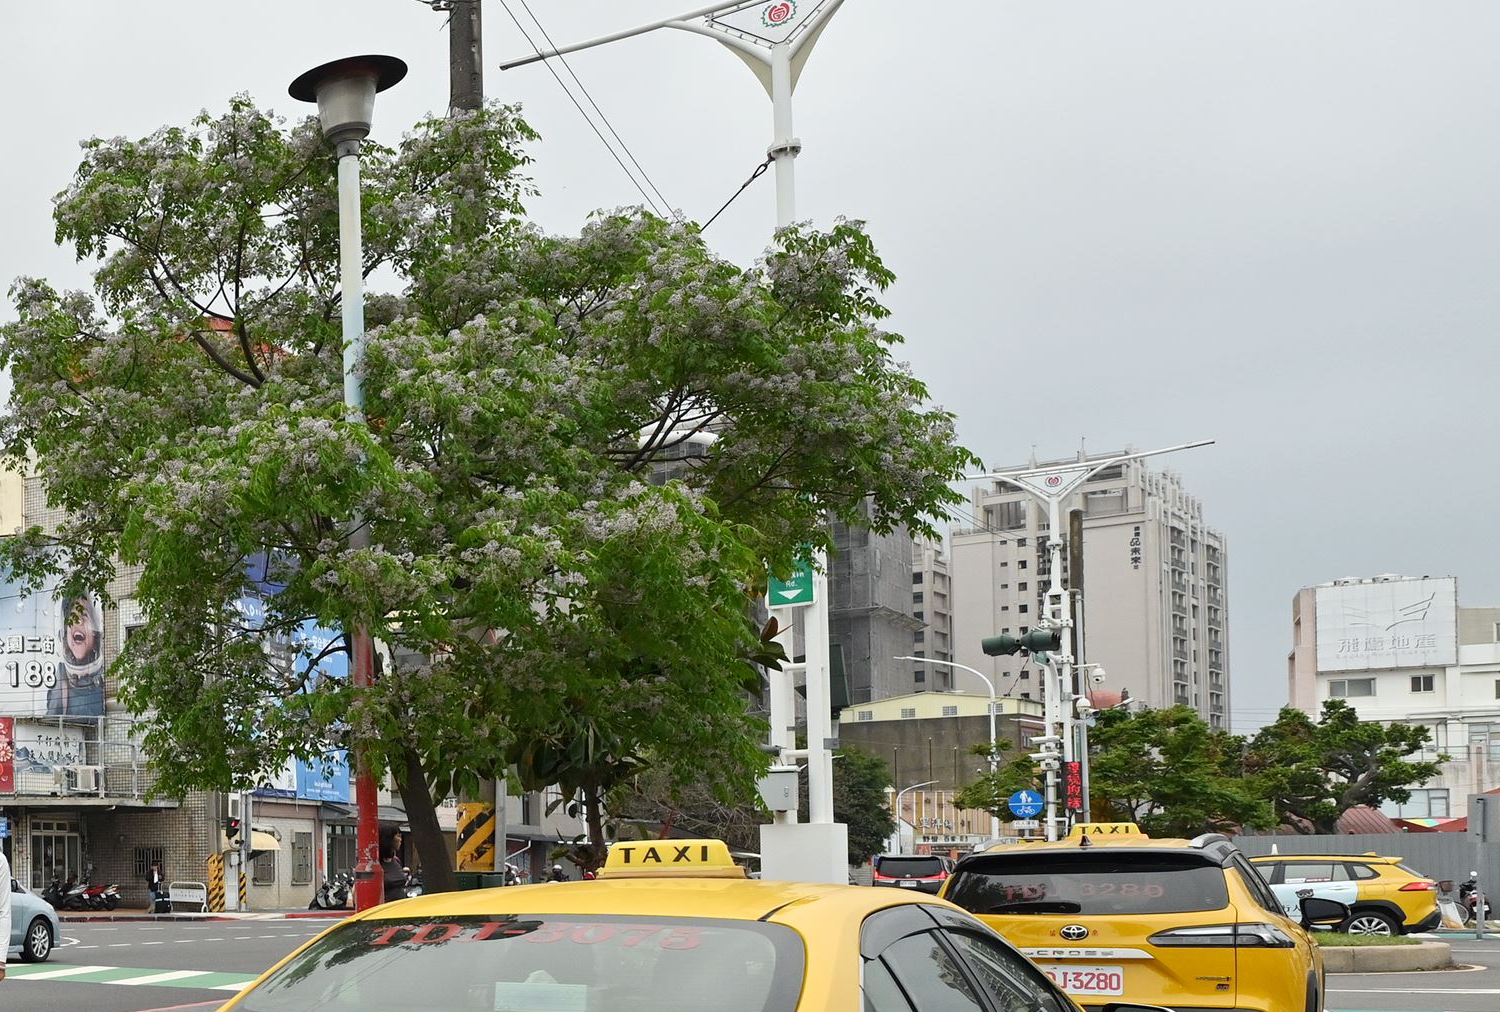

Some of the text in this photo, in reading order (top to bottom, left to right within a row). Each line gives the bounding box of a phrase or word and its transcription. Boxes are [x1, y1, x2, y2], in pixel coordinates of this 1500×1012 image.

[1079, 825, 1130, 834] TAXI
[619, 845, 708, 864] TAXI
[370, 919, 706, 951] TDJ-3075
